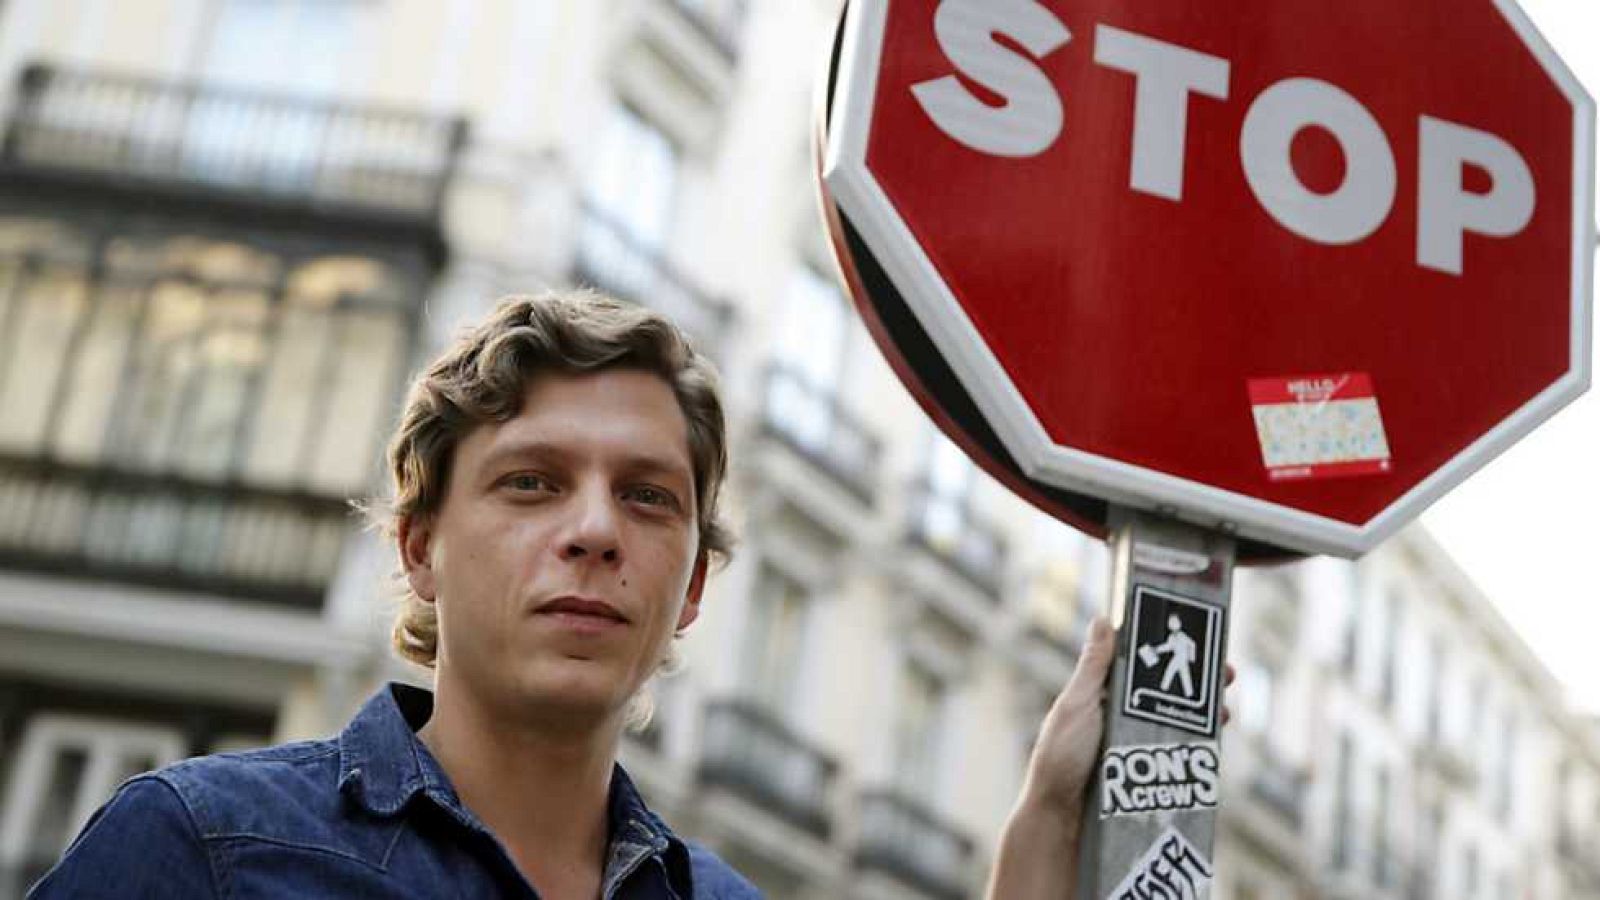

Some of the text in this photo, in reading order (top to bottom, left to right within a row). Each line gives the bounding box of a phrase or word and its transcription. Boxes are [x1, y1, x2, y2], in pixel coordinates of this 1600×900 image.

[911, 0, 1536, 276] STOP
[1103, 747, 1218, 812] RON'S
[1131, 784, 1192, 808] crew
